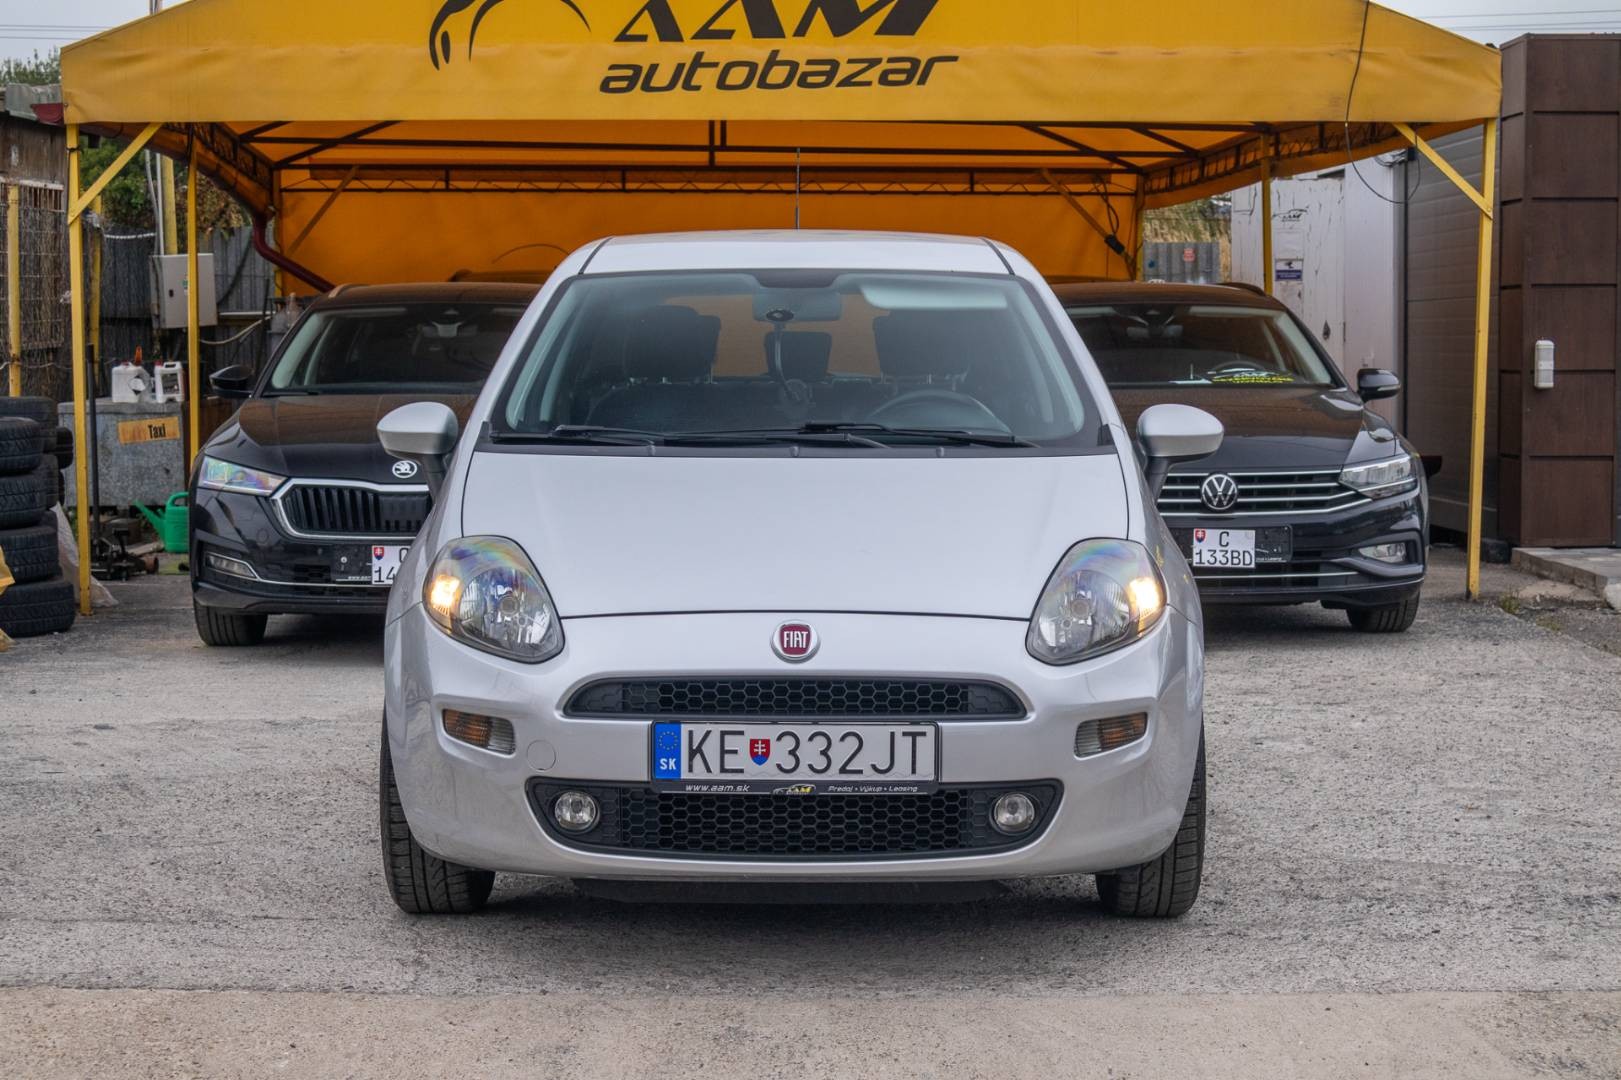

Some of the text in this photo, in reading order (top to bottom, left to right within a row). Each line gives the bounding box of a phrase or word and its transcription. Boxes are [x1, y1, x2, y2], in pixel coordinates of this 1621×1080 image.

[613, 0, 940, 42] AAM
[599, 50, 959, 94] autobazar
[147, 423, 166, 439] Taxi
[1219, 531, 1230, 547] C
[1195, 549, 1253, 566] 133BD
[783, 631, 809, 648] FIAT
[659, 730, 927, 775] SK KE 332JT
[685, 784, 751, 792] www.aam.sk
